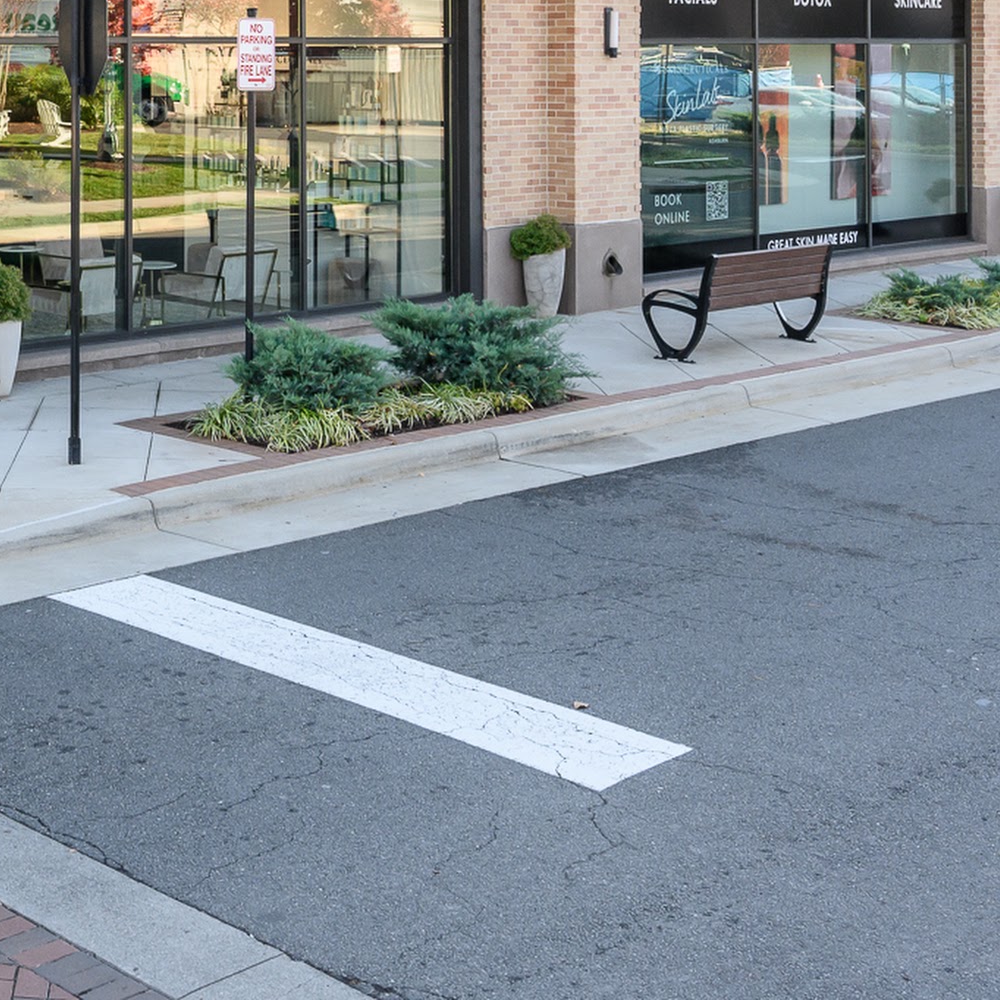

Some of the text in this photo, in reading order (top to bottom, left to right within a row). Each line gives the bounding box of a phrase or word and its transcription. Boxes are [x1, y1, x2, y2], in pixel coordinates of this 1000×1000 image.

[249, 23, 264, 34] NO
[240, 35, 273, 45] PARKING
[240, 53, 273, 63] STANDING
[240, 64, 272, 77] FIRE LANE
[654, 193, 682, 207] BOOK
[654, 210, 690, 226] ONLINE
[767, 238, 794, 250] GREAT
[796, 235, 815, 247] SKIN
[839, 230, 859, 245] EASY
